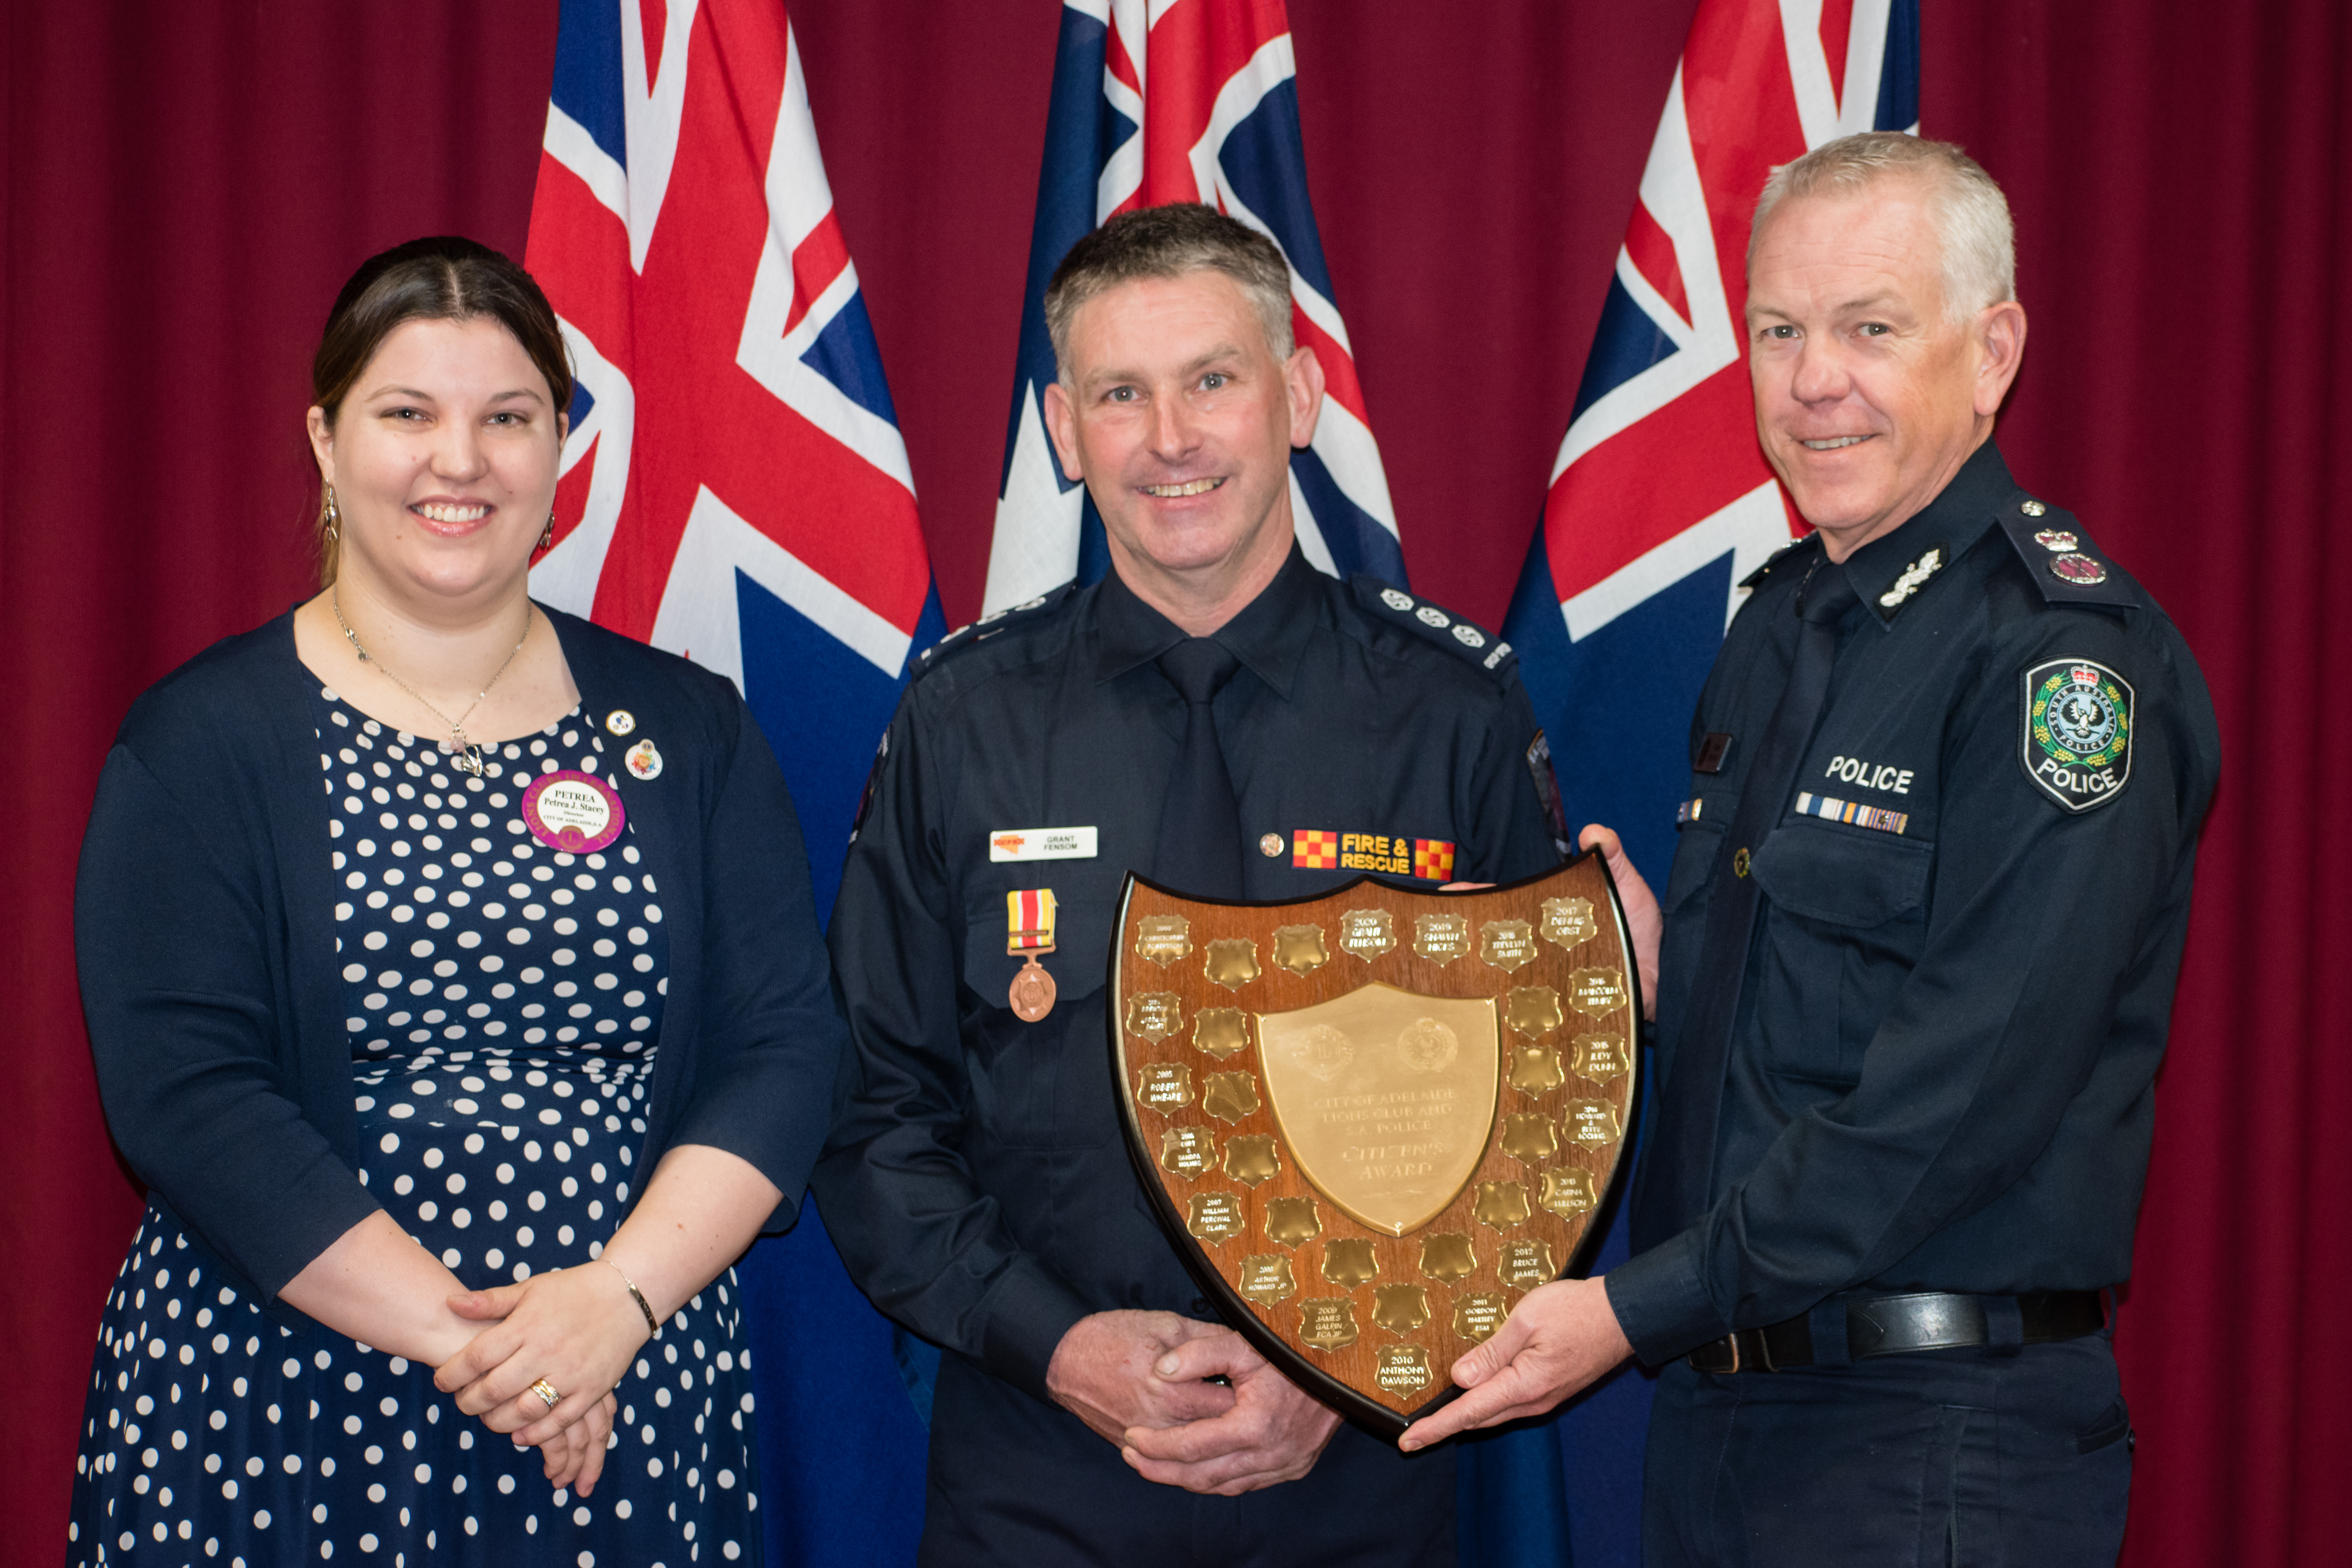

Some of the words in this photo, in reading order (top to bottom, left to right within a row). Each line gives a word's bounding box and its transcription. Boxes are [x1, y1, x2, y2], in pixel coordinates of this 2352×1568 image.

[2050, 690, 2069, 726] SOUTH
[2075, 685, 2115, 734] AUSTRALIA
[2059, 735, 2104, 750] POLICE
[1825, 756, 1914, 794] POLICE
[2037, 758, 2118, 793] POLICE
[555, 790, 595, 803] PETREA
[544, 798, 569, 808] Petrea
[571, 801, 578, 810] J.
[580, 802, 605, 815] Stacey
[1047, 835, 1075, 843] GRANT
[1342, 833, 1390, 855] FIRE
[1394, 838, 1410, 858] &
[1341, 853, 1410, 874] RESCUE
[1556, 907, 1577, 915] 2017
[1354, 917, 1377, 926] 2020
[1551, 916, 1585, 926] DENNIS
[1352, 927, 1381, 937] GRANT
[1429, 923, 1452, 931] 2019
[1498, 949, 1522, 958] SMITH
[1591, 1041, 1609, 1050] 2015
[1591, 1052, 1612, 1061] JUDY
[1589, 1062, 1616, 1072] DUNN
[1156, 1070, 1173, 1079] 2005
[1150, 1082, 1180, 1092] ROBERT
[1315, 1097, 1350, 1109] CITY
[1354, 1094, 1374, 1106] OF
[1381, 1088, 1457, 1104] ADELAIDE
[1324, 1110, 1369, 1123] LIONS
[1373, 1107, 1414, 1119] CLUB
[1418, 1103, 1453, 1116] AND
[1377, 1120, 1433, 1134] POLICE
[1360, 1162, 1433, 1179] AWARD
[1514, 1248, 1534, 1256] 2012
[1513, 1258, 1538, 1267] BRUCE
[1514, 1269, 1539, 1278] JAMES
[1316, 1314, 1341, 1322] JAMES
[1391, 1356, 1414, 1364] 2010
[1380, 1366, 1424, 1374] ANTHONY
[1381, 1376, 1425, 1384] DAWSON
